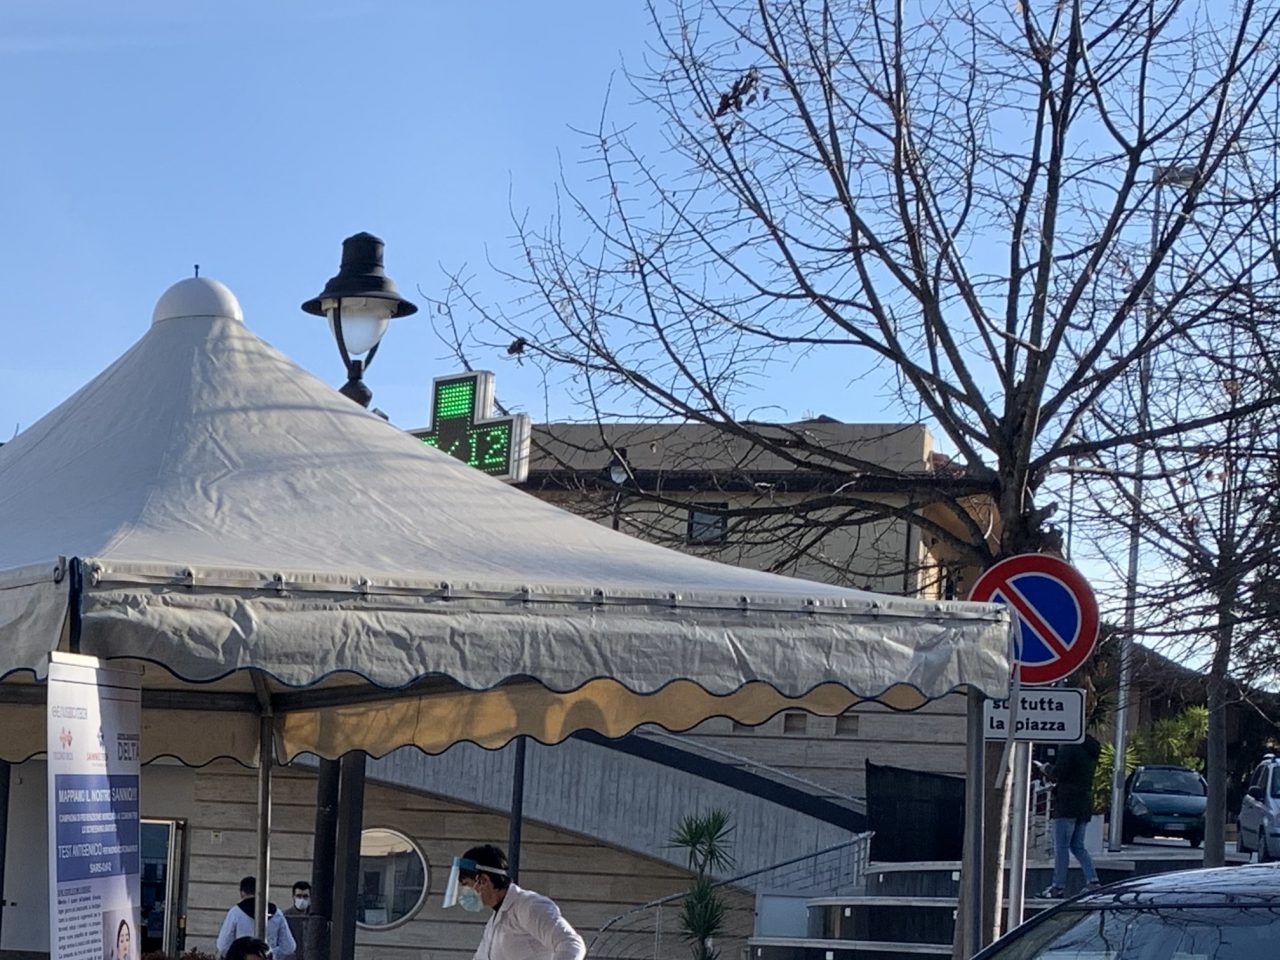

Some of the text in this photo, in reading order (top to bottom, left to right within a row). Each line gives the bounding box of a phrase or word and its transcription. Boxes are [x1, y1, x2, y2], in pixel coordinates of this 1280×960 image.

[1021, 697, 1064, 711] tutta
[989, 716, 1066, 732] la piazza
